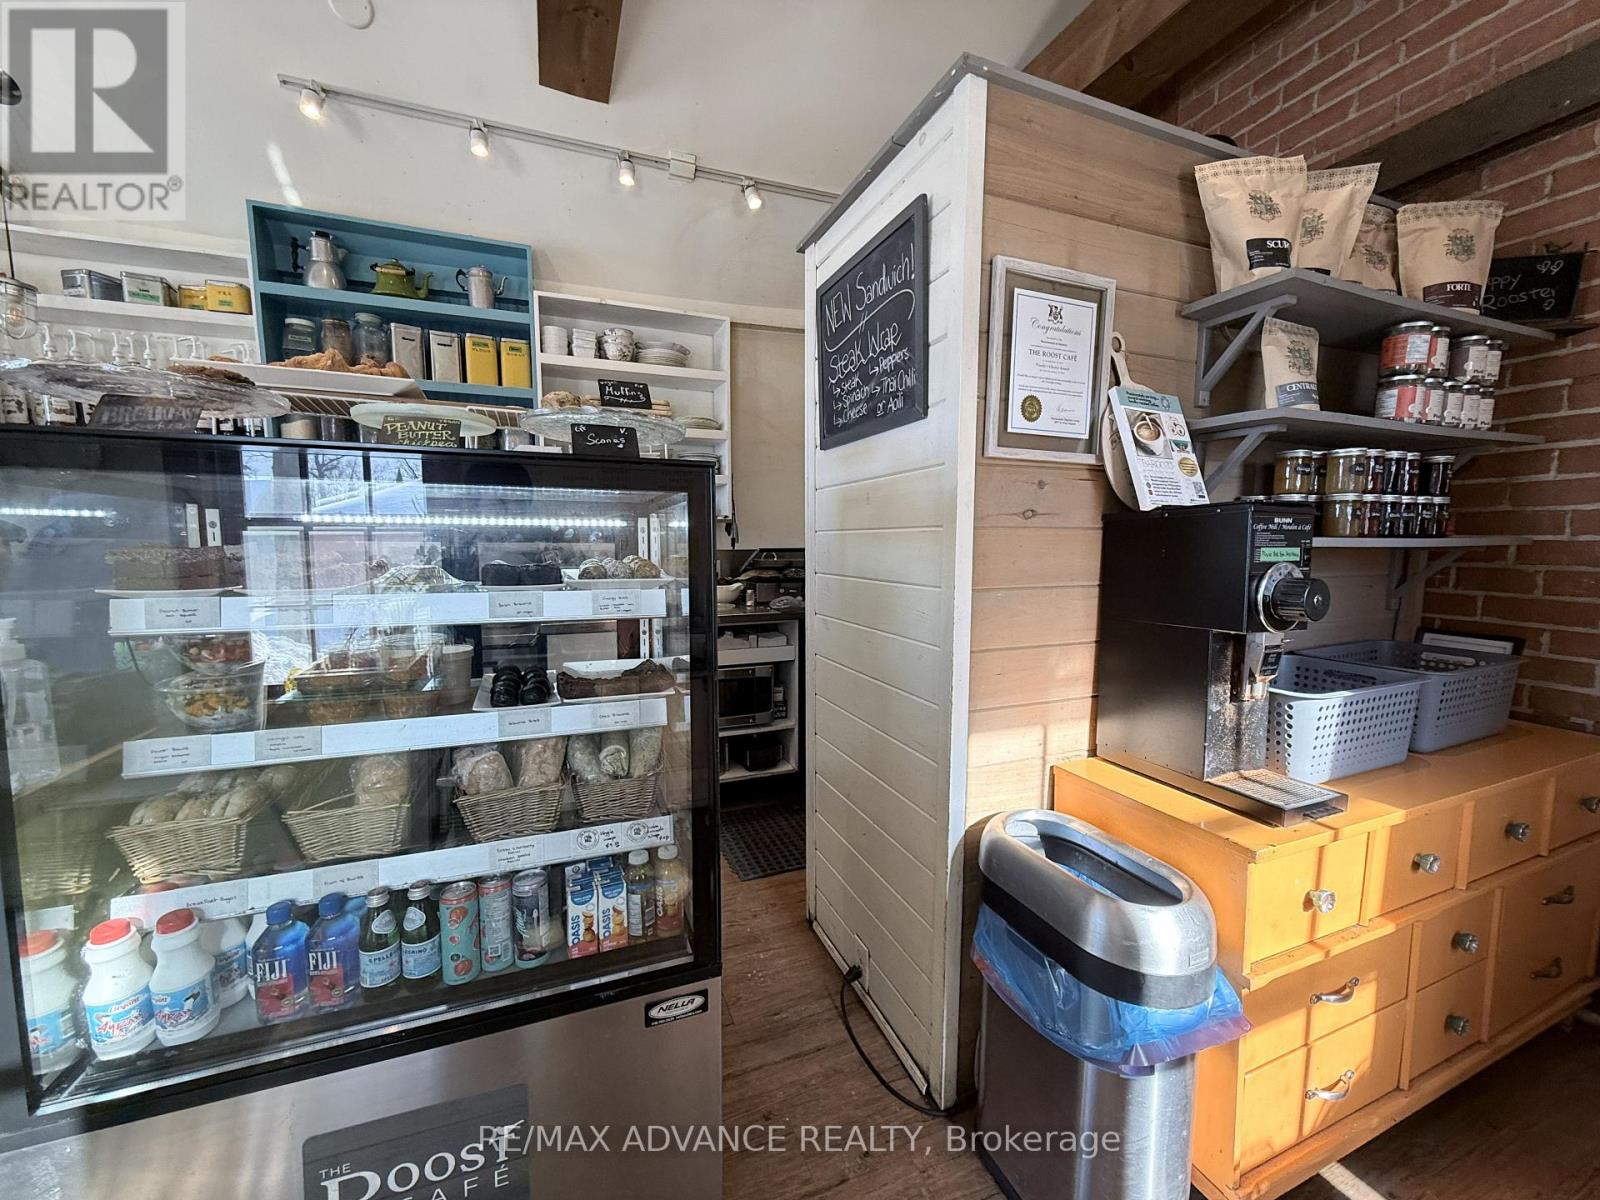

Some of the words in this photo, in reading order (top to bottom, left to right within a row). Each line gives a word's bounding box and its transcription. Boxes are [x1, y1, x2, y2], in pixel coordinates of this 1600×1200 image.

[825, 283, 851, 336] NEW
[856, 242, 915, 310] Sandwich!
[829, 340, 866, 384] Steak
[867, 321, 902, 353] Wrap
[1028, 348, 1041, 357] THE
[1042, 350, 1061, 360] ROOST
[384, 421, 447, 435] PEANUT
[398, 431, 456, 440] BUTTER
[571, 914, 581, 946] OASIS
[603, 908, 611, 939] OASIS
[256, 959, 288, 983] FIJI
[309, 951, 338, 971] FIJI
[658, 998, 696, 1013] NELLA
[319, 1162, 352, 1179] THE
